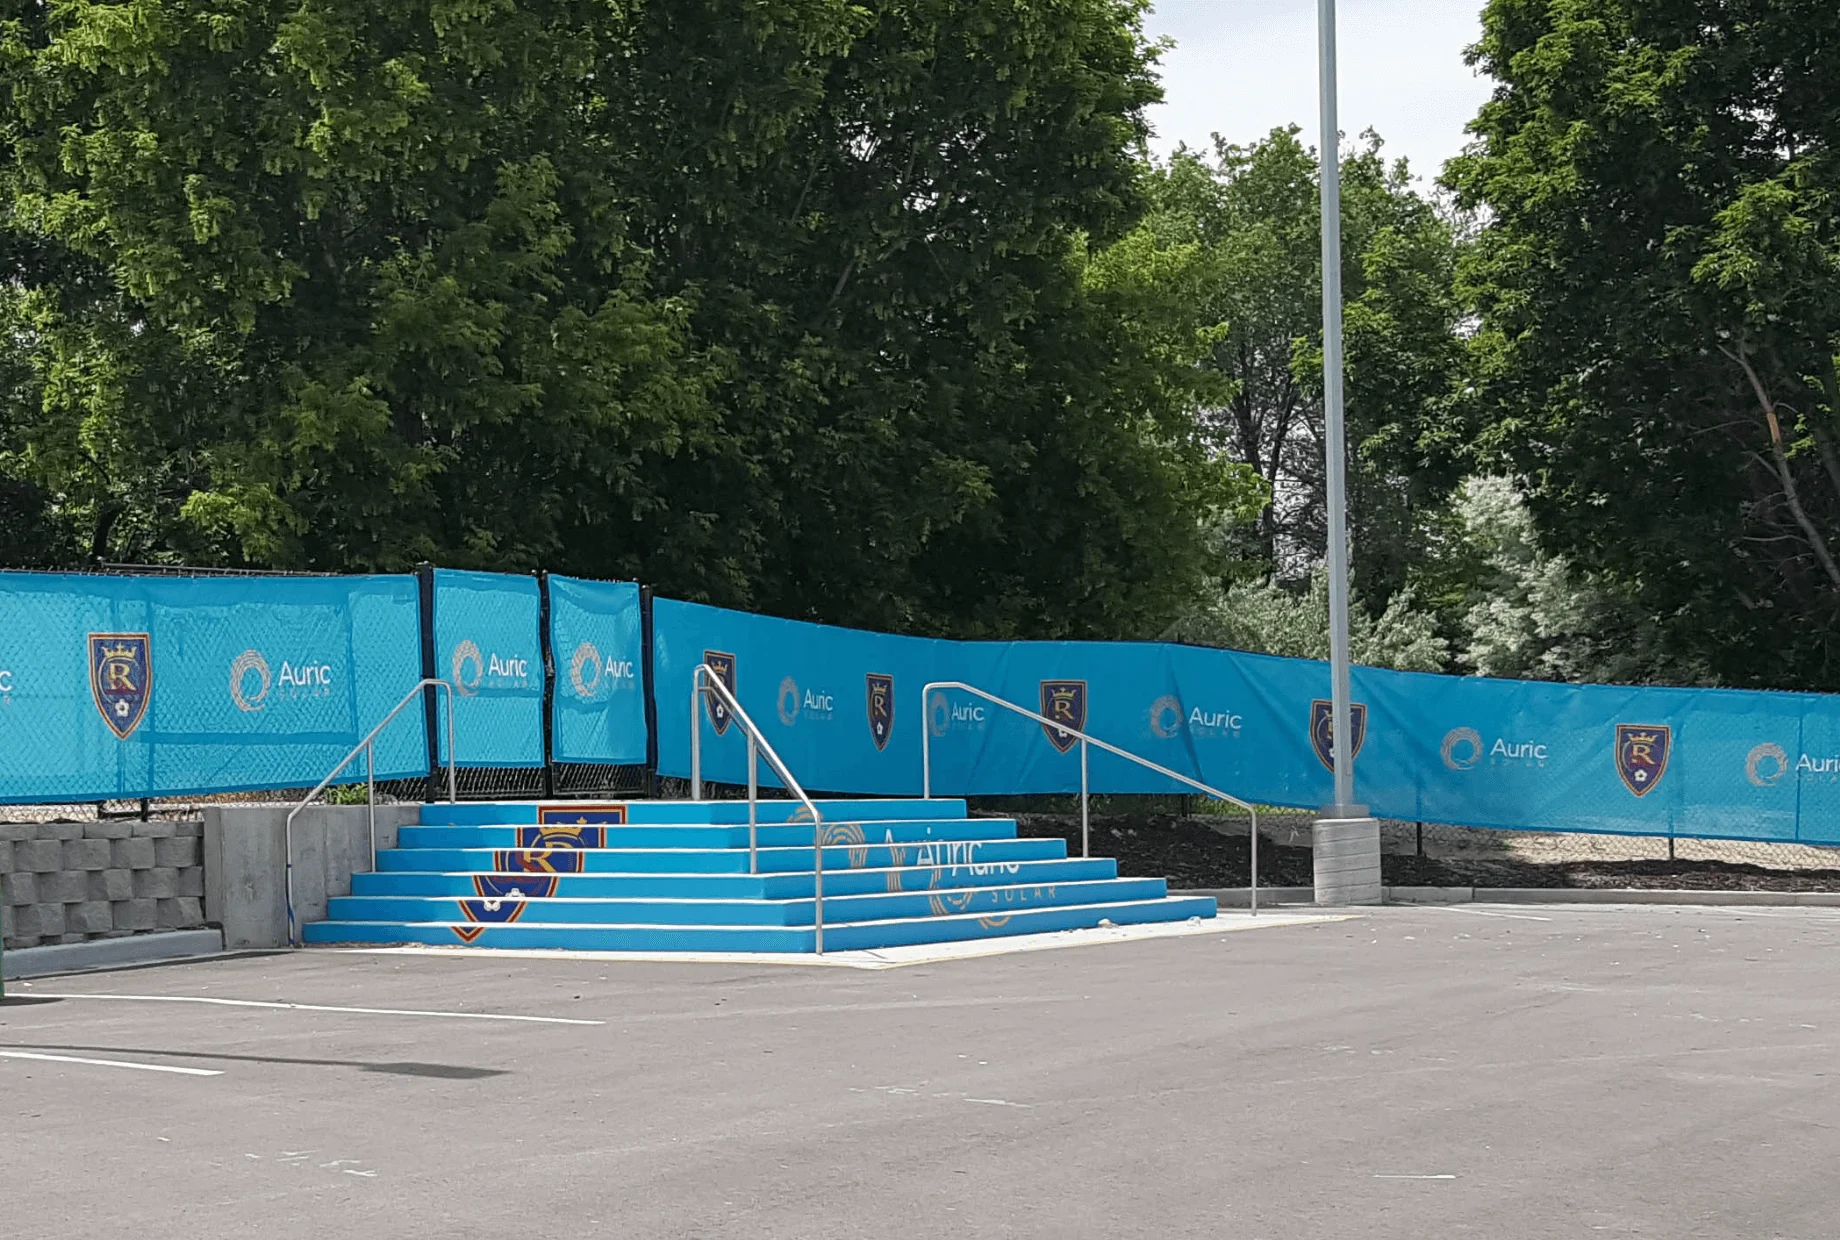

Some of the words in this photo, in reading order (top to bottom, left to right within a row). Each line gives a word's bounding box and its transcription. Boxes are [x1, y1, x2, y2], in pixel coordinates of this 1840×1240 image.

[278, 660, 330, 687] Auric
[488, 653, 528, 677] Auric
[604, 655, 634, 678] Auric
[803, 688, 833, 711] Auric
[951, 701, 985, 721] Auric
[1188, 706, 1242, 729] Auric
[1489, 738, 1548, 759] Auric
[1795, 753, 1840, 773] Auri
